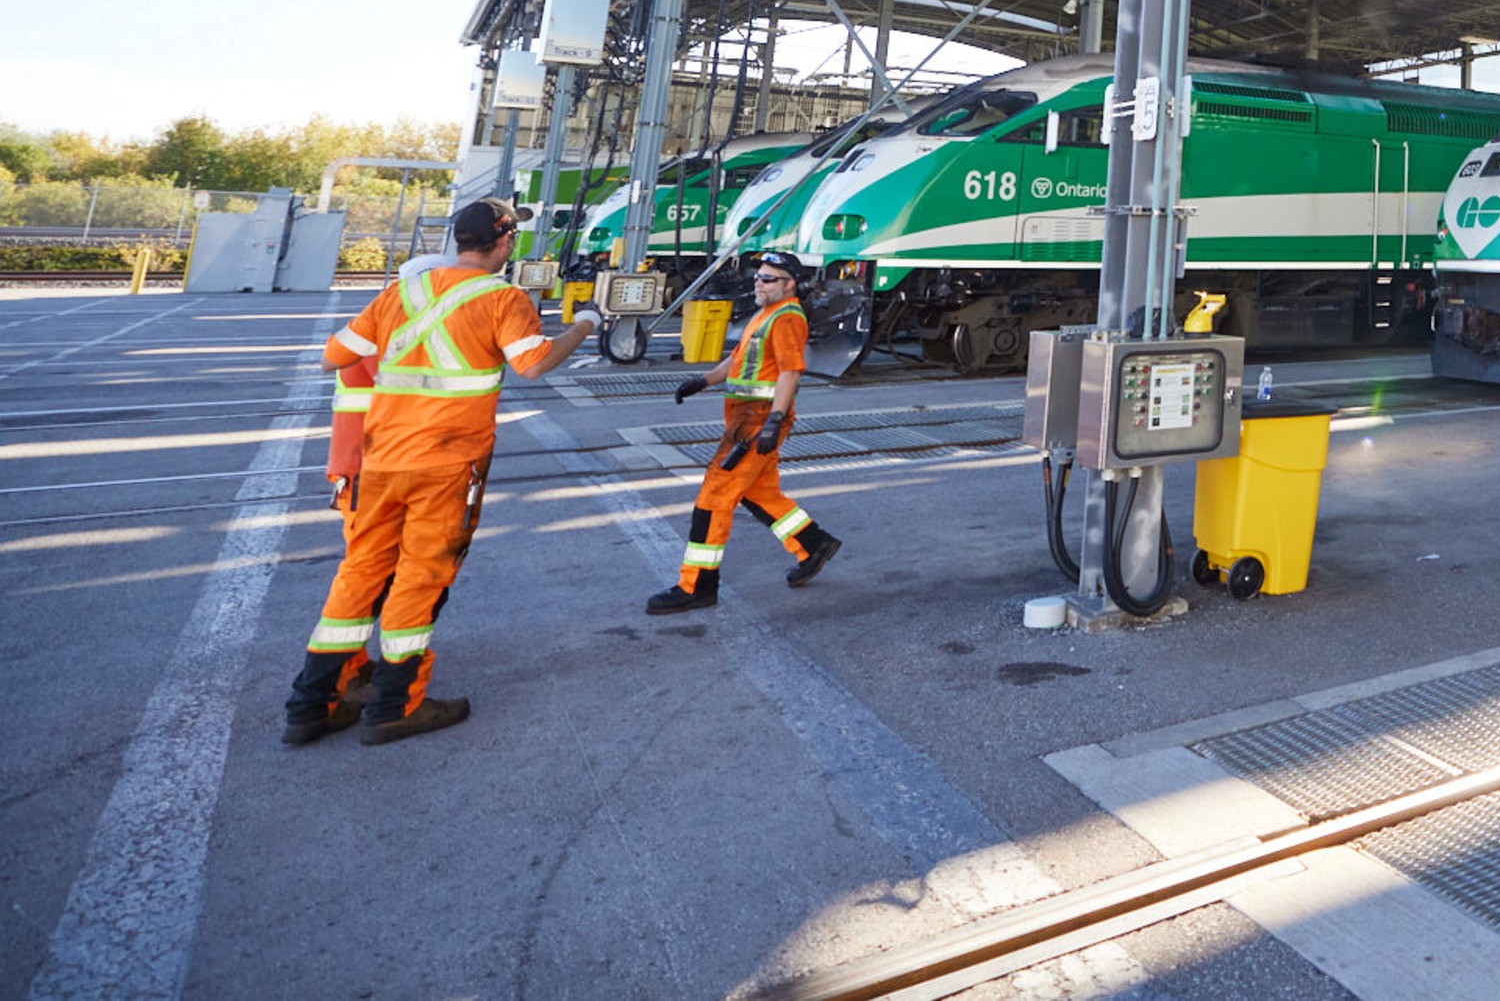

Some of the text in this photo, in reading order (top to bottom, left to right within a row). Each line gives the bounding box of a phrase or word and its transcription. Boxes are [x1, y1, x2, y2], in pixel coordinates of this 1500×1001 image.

[1143, 100, 1155, 130] 5
[1462, 163, 1480, 177] 603
[964, 169, 1017, 201] 618
[1056, 181, 1108, 198] Ontario
[667, 204, 701, 222] 657
